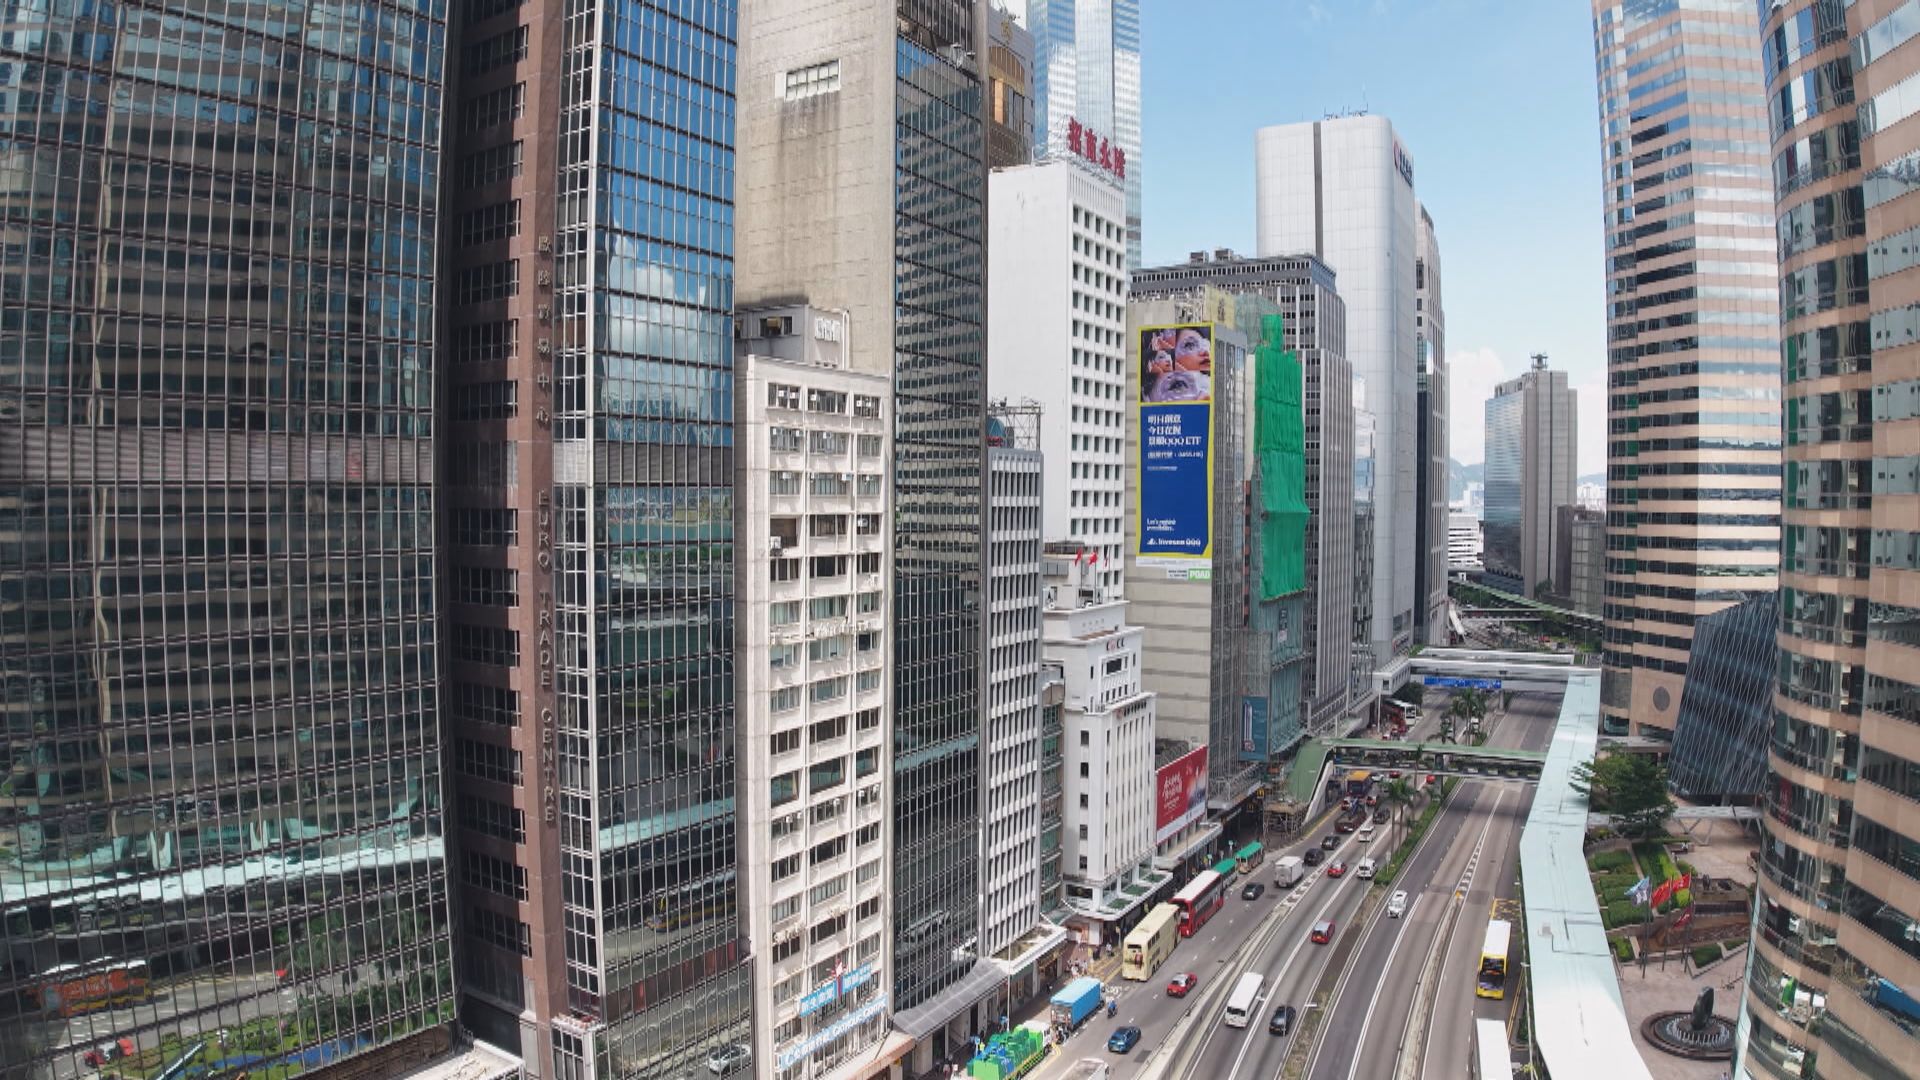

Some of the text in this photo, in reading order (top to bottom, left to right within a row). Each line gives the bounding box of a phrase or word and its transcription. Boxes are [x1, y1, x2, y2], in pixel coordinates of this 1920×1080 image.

[538, 489, 555, 822] EURO TRADE CENTRE
